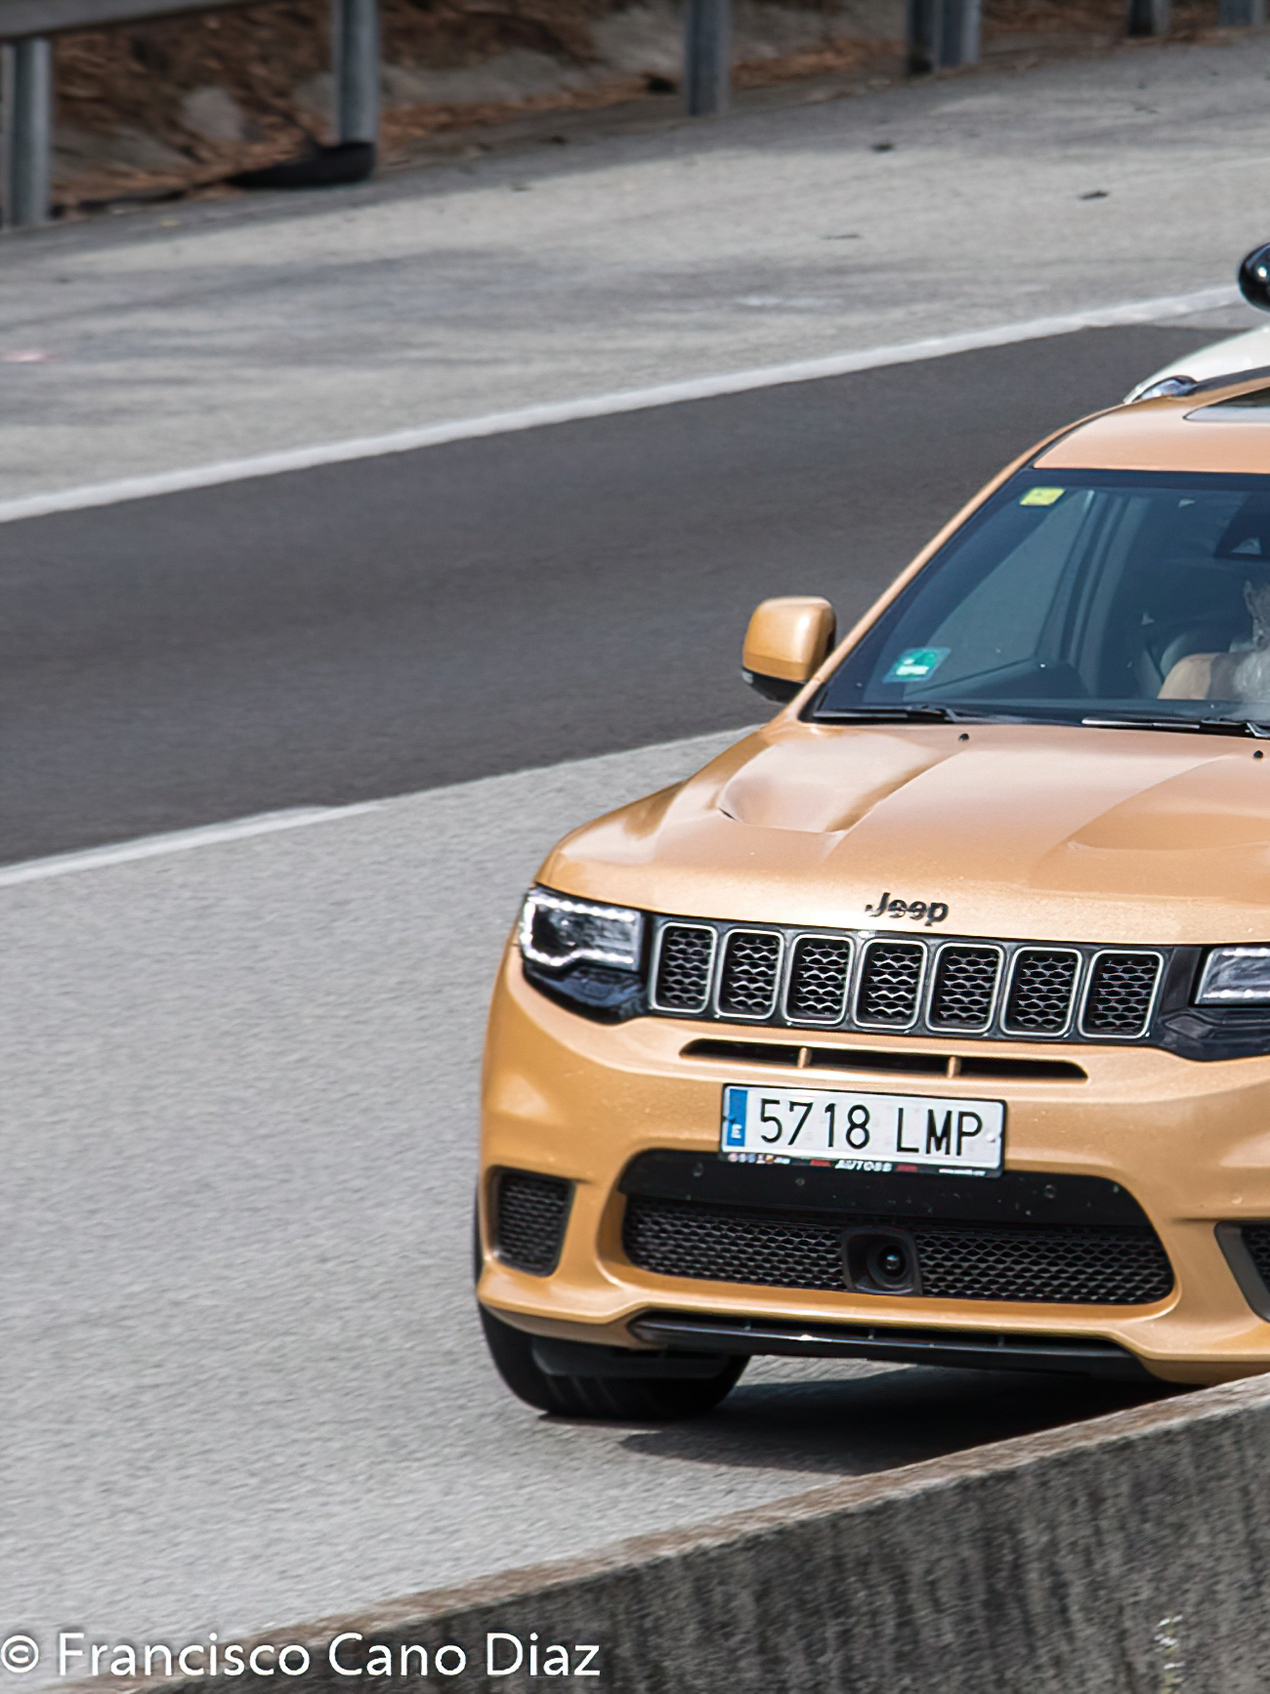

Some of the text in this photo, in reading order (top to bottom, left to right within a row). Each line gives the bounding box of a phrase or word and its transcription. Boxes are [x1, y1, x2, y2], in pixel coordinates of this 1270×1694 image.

[865, 892, 949, 926] Jeep
[760, 1098, 870, 1150] 5718
[896, 1107, 983, 1157] LMP
